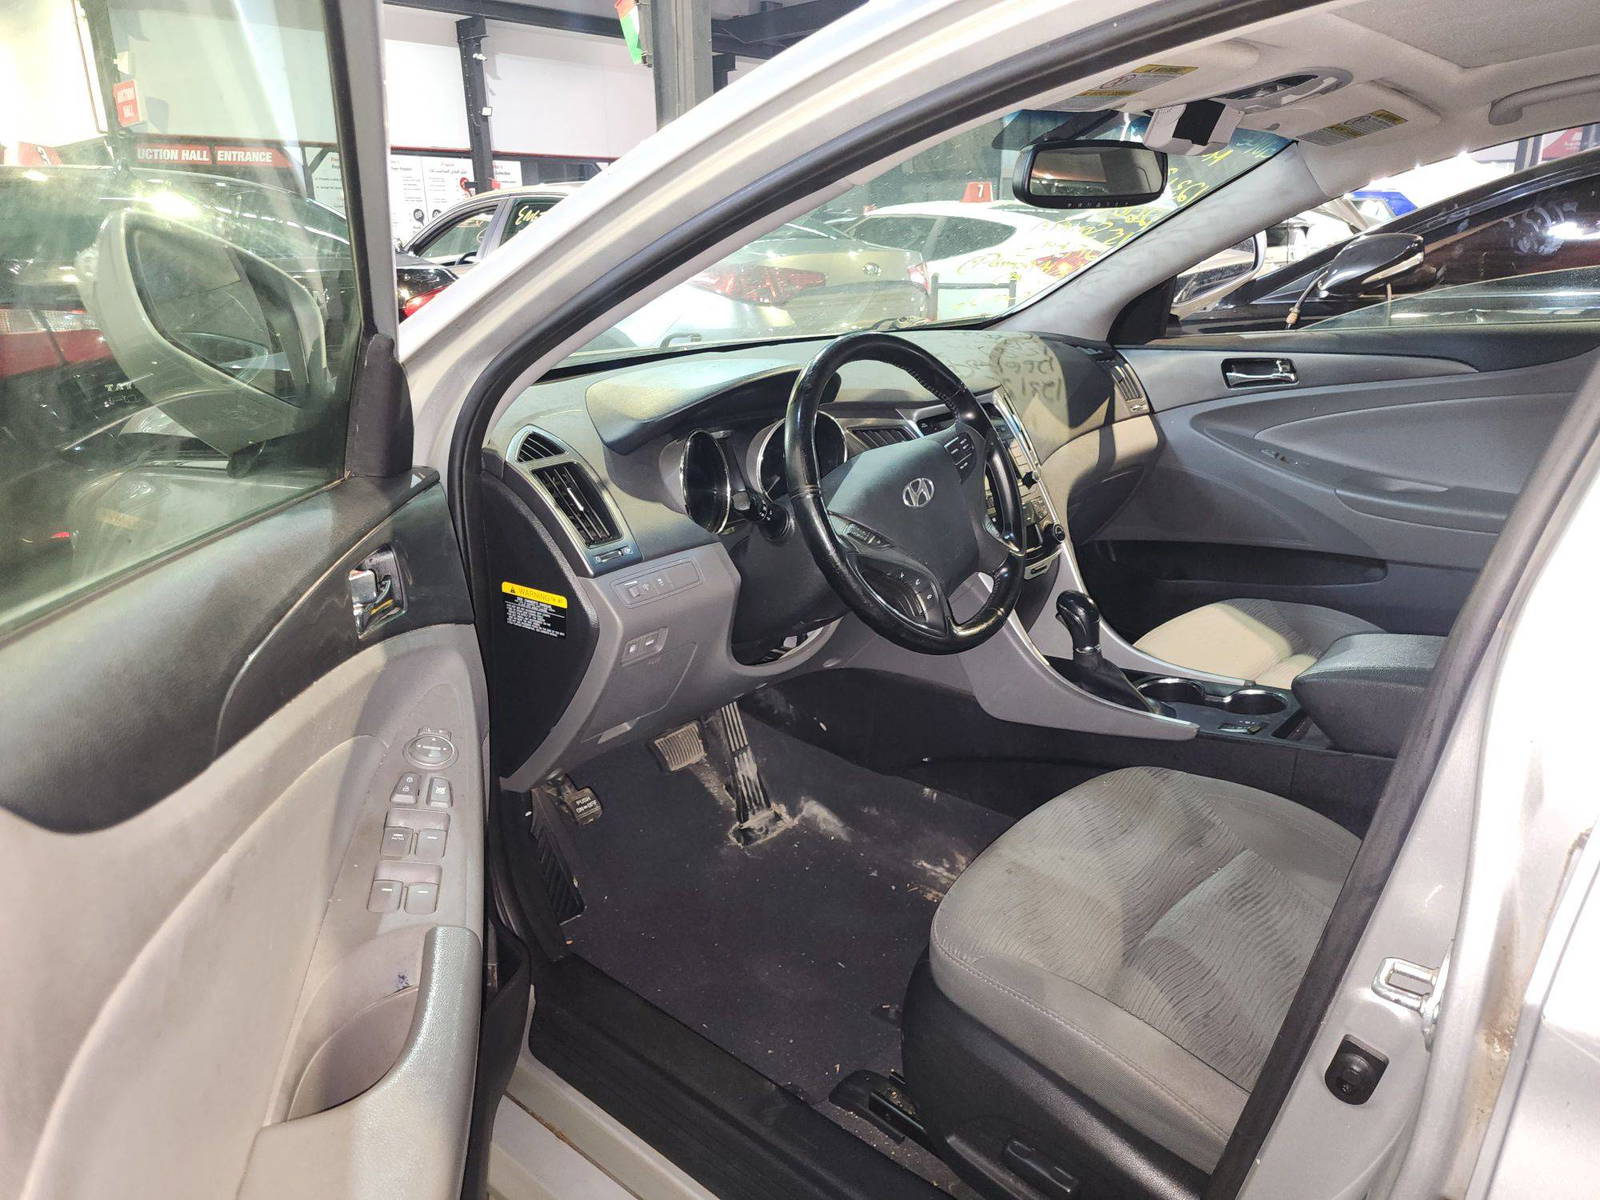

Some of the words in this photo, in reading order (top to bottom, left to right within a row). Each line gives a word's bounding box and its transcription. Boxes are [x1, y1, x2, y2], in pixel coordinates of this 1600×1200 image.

[137, 148, 178, 160] UCTION
[181, 149, 209, 161] HALL
[217, 150, 272, 162] ENTRANCE
